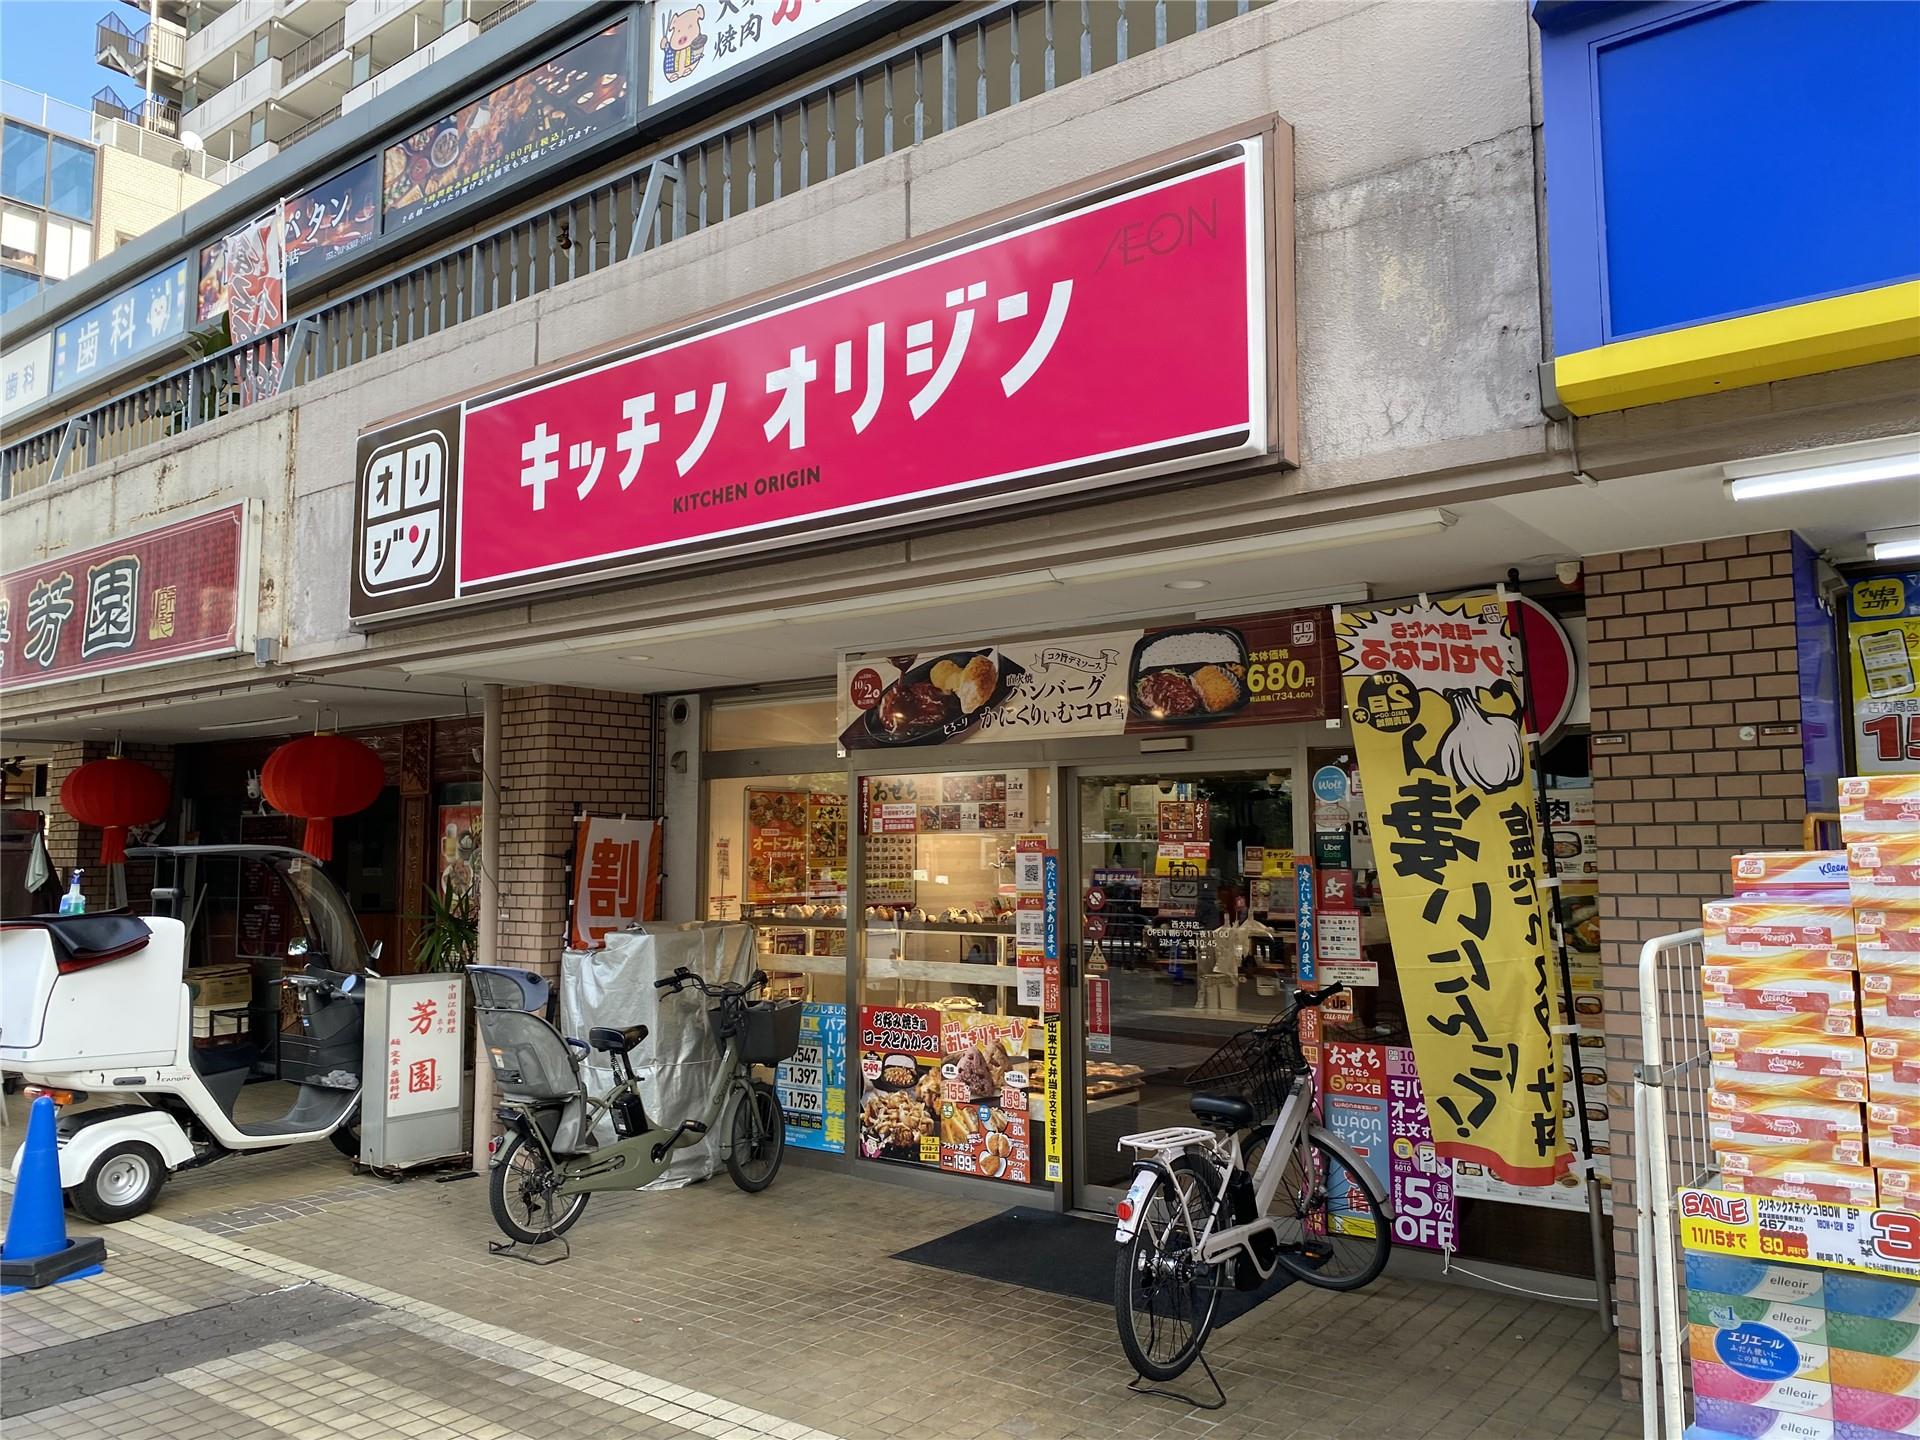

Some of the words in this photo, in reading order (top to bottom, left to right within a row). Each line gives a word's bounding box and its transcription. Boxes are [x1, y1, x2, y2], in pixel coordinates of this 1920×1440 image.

[713, 13, 762, 61] 焼肉
[77, 298, 136, 374] 歯科
[6, 361, 35, 400] 歯科
[520, 382, 727, 511] キッチン
[764, 280, 1074, 449] オリジン
[374, 446, 434, 513] オリ
[673, 481, 748, 514] KITCHEN
[754, 465, 821, 500] ORIGIN
[371, 527, 431, 580] ジン
[1857, 585, 1897, 600] マツキヨ
[1862, 596, 1899, 610] ココカラ
[1047, 652, 1102, 670] コク旨デミソース
[1249, 649, 1289, 662] 本体価格
[1247, 660, 1315, 692] 680円
[1007, 674, 1107, 702] ハンバーグ
[873, 779, 918, 801] おせち
[1318, 781, 1342, 790] Wolt
[752, 836, 805, 851] オードブル
[1171, 920, 1200, 929] 西大井店
[1298, 868, 1313, 977] 冷たい麦茶あります。
[1147, 929, 1167, 937] OPEN
[825, 1018, 835, 1057] パート
[863, 1029, 933, 1052] ロースとんかつ
[945, 1018, 1026, 1053] おにぎりセール
[408, 999, 438, 1094] 芳園
[836, 1018, 846, 1085] アルバイト
[1329, 1045, 1381, 1069] おせち
[1341, 1067, 1370, 1077] 買うなら
[1345, 1083, 1382, 1096] のつく日
[1332, 1128, 1382, 1146] ポイント
[1683, 1192, 1749, 1225] SALE
[1847, 1208, 1860, 1220] 5P
[1395, 1215, 1455, 1248] OFF
[1759, 1219, 1787, 1230] 467
[1692, 1226, 1747, 1249] 11/15まで
[1762, 1236, 1784, 1252] 30
[1770, 1276, 1809, 1289] elleair
[1713, 1306, 1735, 1321] No.1
[1772, 1312, 1812, 1326] elleair
[1728, 1332, 1785, 1350] エリエール
[1778, 1386, 1819, 1400] elleair
[1780, 1422, 1821, 1437] elleair
